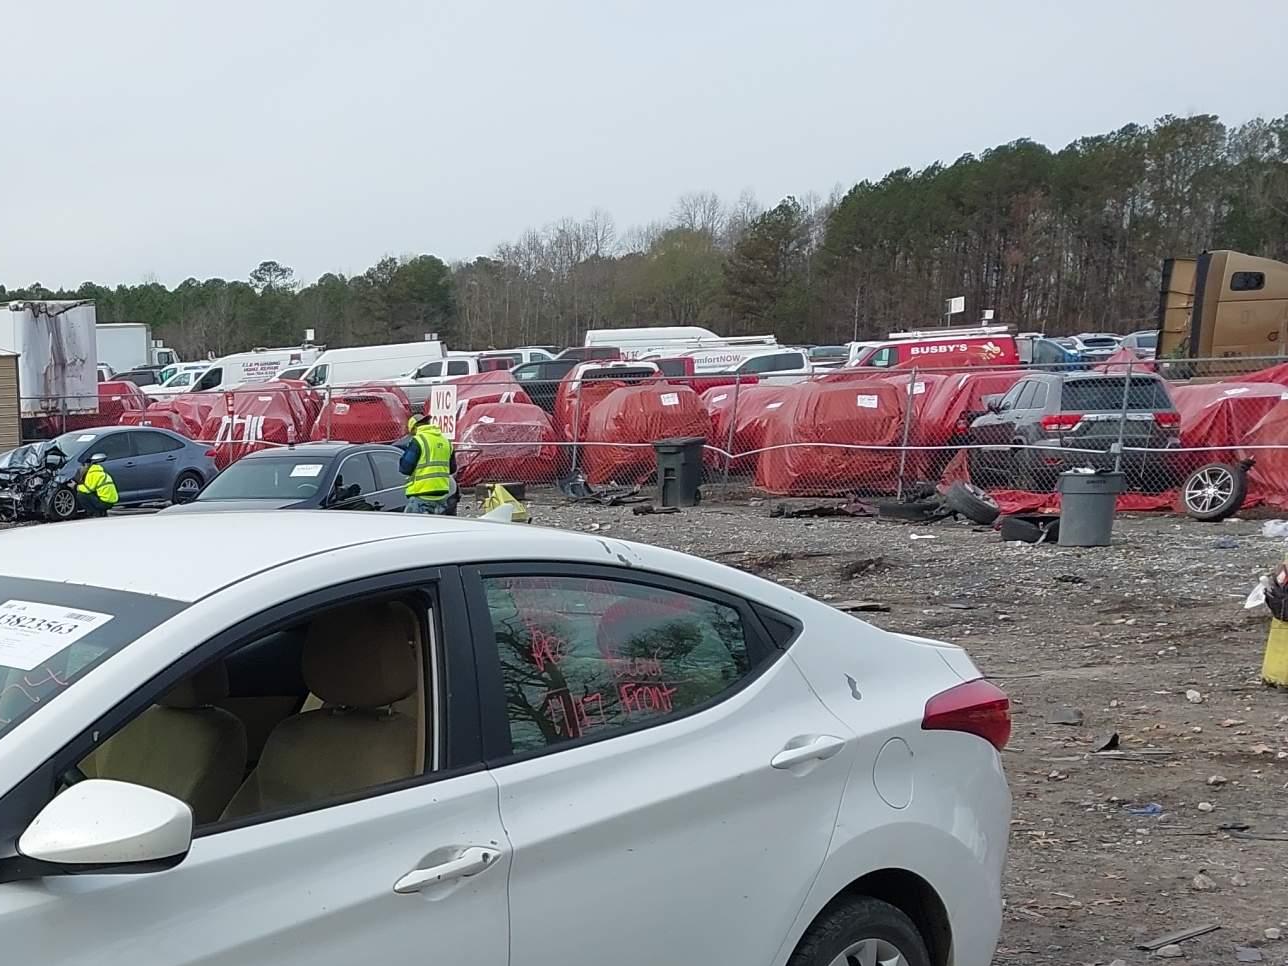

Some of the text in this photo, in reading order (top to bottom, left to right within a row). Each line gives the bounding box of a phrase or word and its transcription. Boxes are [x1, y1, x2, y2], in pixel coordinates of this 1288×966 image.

[910, 344, 968, 355] BUSBY'S
[693, 355, 740, 364] omfortNOW
[436, 391, 451, 409] VIC
